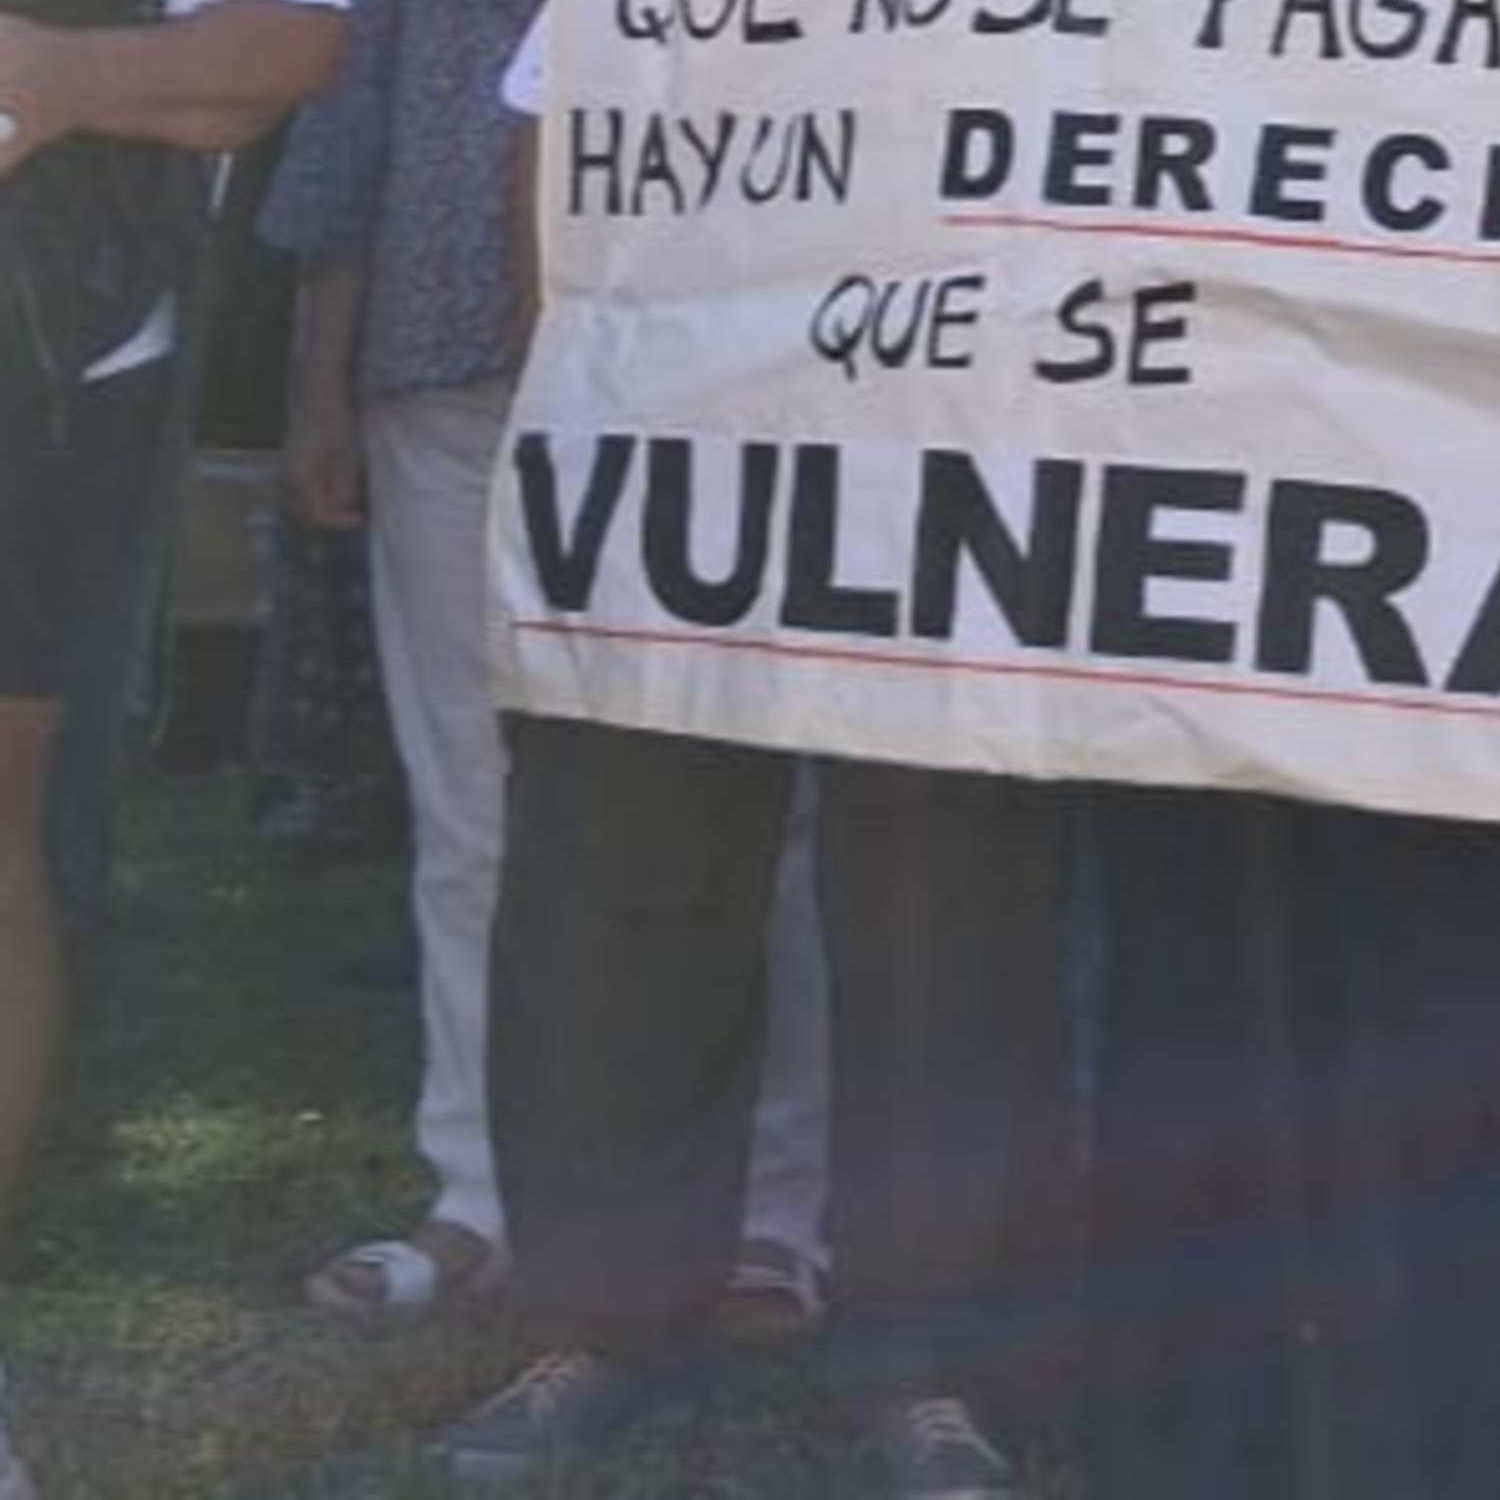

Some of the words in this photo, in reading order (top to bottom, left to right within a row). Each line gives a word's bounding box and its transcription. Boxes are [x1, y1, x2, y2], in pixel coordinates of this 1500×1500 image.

[568, 108, 737, 217] HAY
[809, 275, 985, 381] QUE
[1034, 279, 1196, 388] SE
